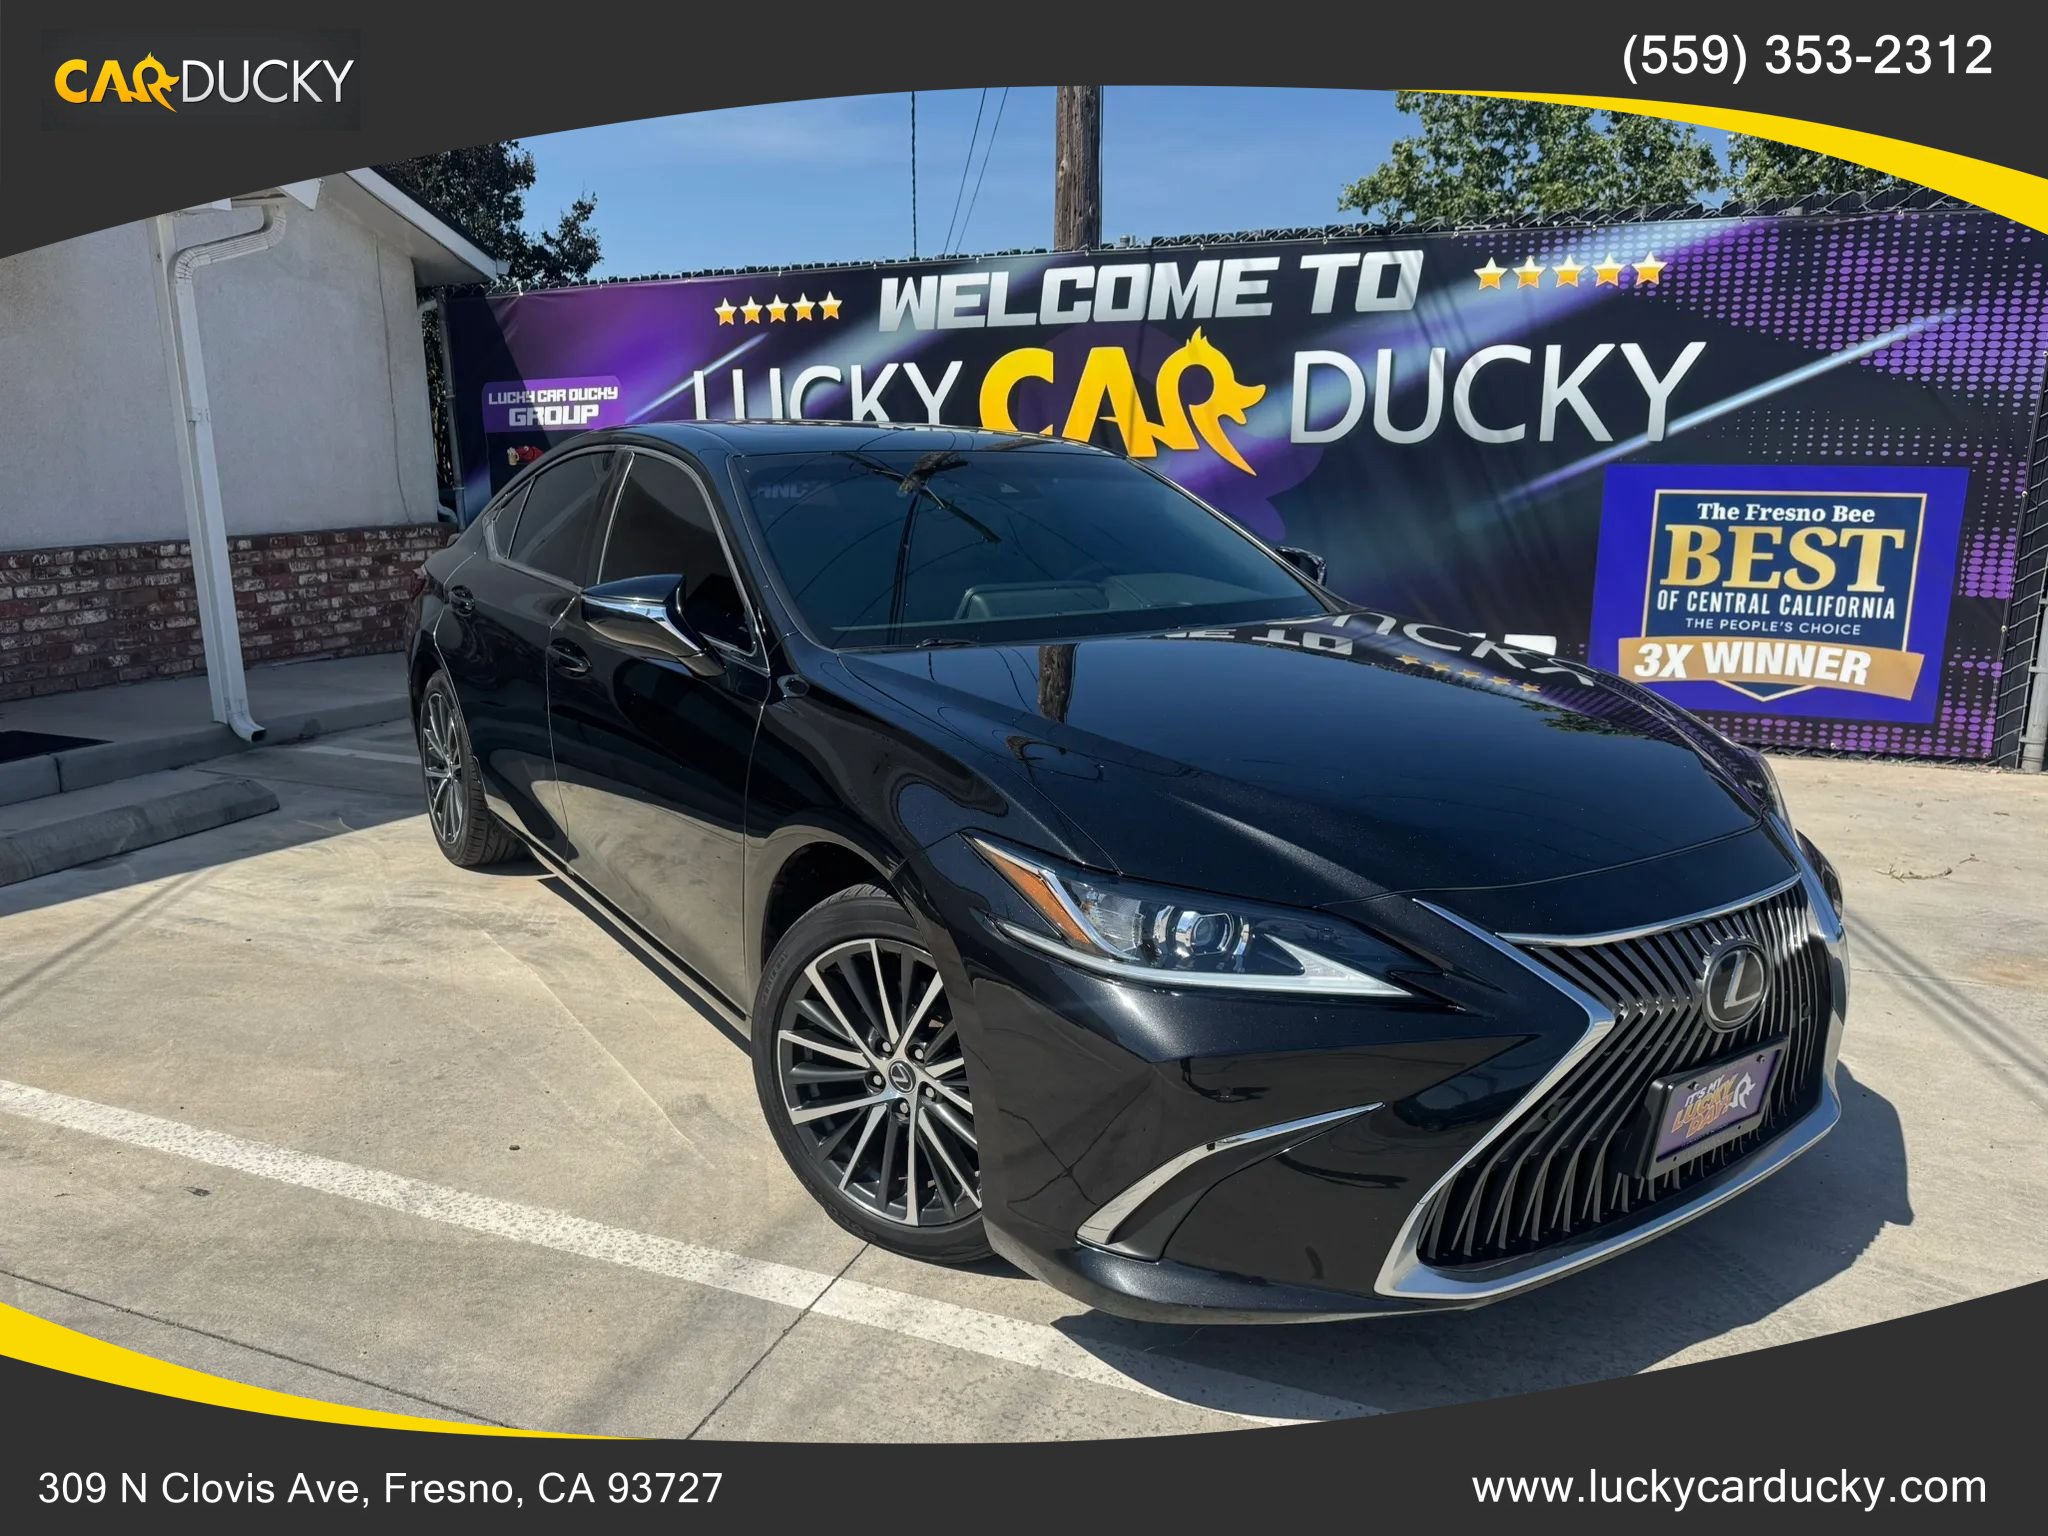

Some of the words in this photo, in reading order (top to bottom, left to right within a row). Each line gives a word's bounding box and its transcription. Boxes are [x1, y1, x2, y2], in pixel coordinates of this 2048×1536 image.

[878, 257, 1280, 332] WELCOME
[1300, 249, 1424, 314] TO
[488, 390, 535, 405] LUCKY
[537, 388, 567, 403] CAR
[568, 386, 619, 401] DUCKY
[979, 325, 1266, 476] CAR
[1290, 341, 1706, 445] DUCKY
[508, 403, 600, 427] GROUP
[1697, 503, 1740, 521] The
[1745, 503, 1826, 522] Fresno
[1832, 504, 1876, 523] Bee
[1660, 524, 1906, 592] BEST
[1656, 589, 1680, 611] OF
[1687, 591, 1771, 617] CENTRAL
[1779, 594, 1896, 620] CALIFORNIA
[1686, 617, 1714, 630] THE
[1720, 618, 1793, 634] PEOPLE'S
[1799, 622, 1861, 636] CHOICE
[1634, 643, 1693, 679] 3X
[1702, 641, 1872, 686] WINNER
[1671, 1073, 1739, 1133] LUCKY
